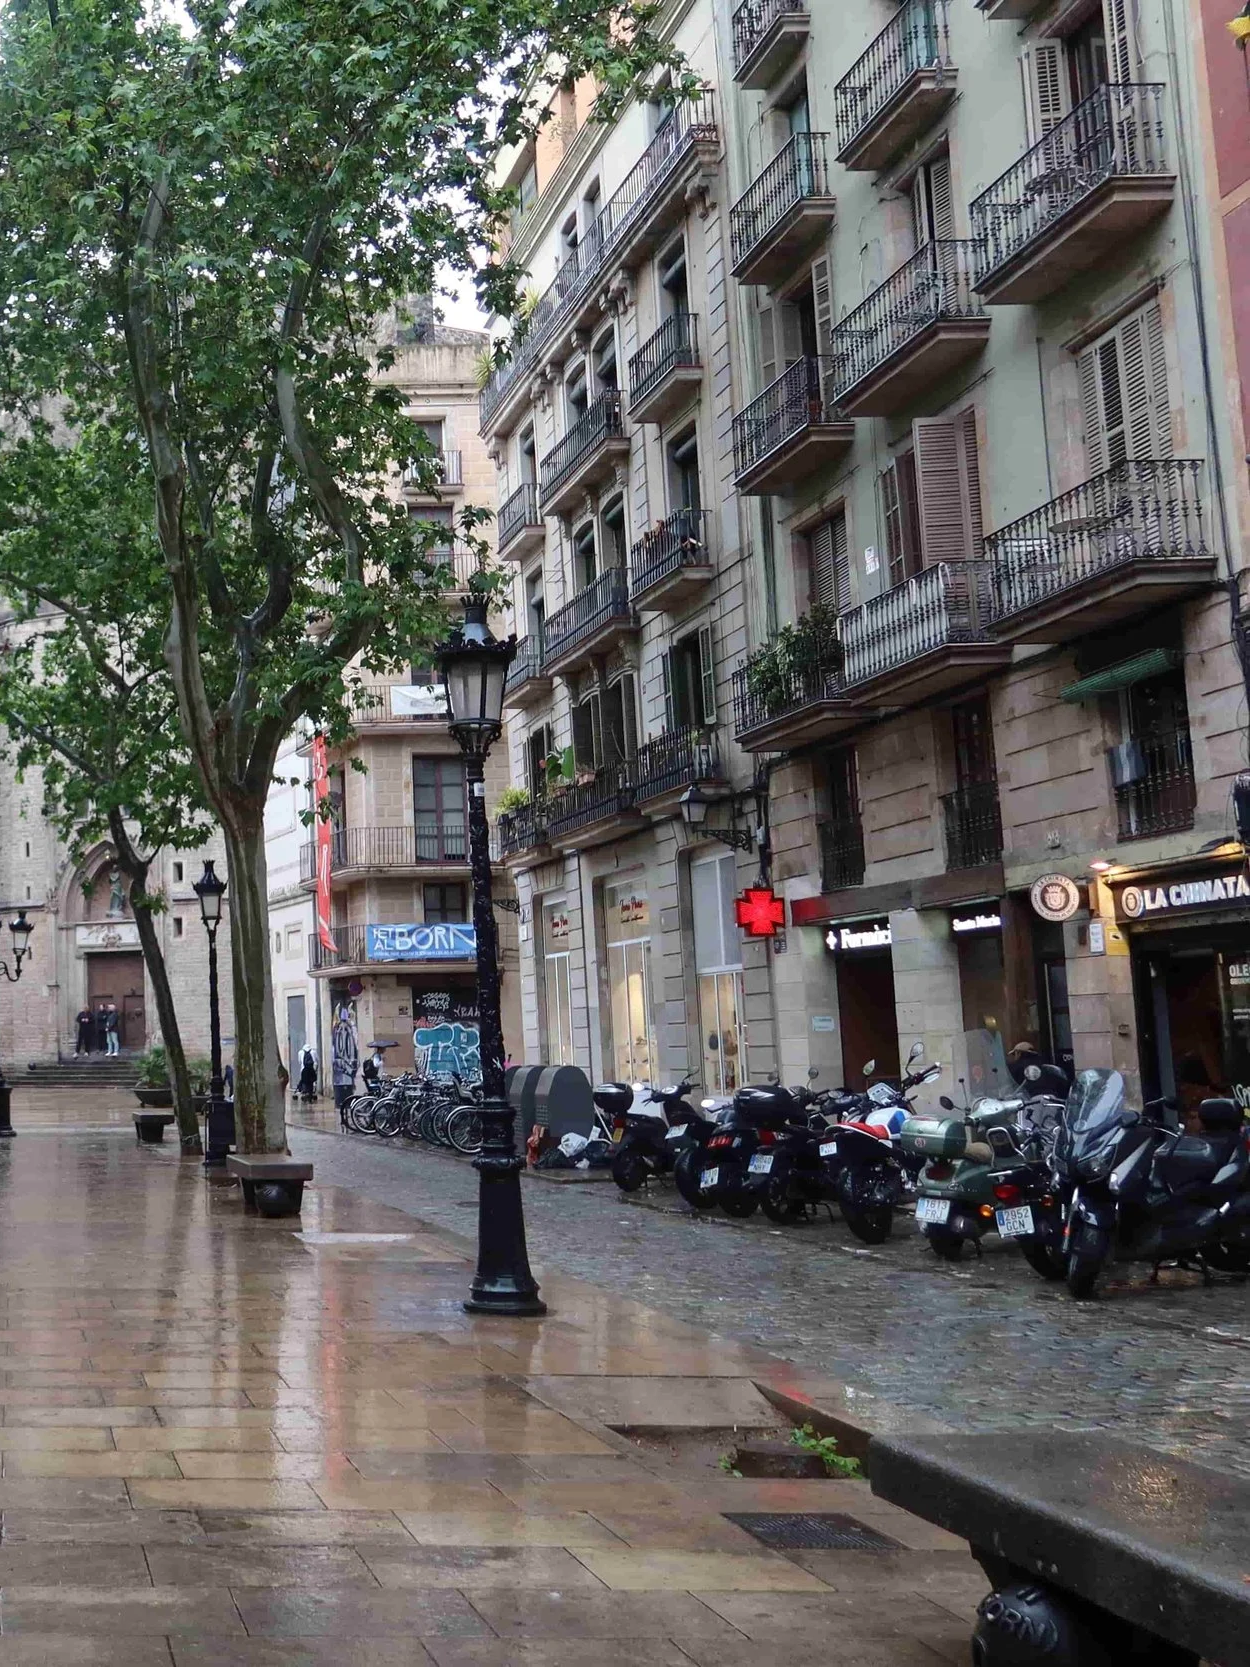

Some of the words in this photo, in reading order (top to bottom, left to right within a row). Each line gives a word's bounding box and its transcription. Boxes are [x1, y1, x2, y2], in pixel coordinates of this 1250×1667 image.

[1144, 888, 1168, 909] LA
[1169, 875, 1250, 906] CHINATA
[1229, 964, 1250, 978] OLE
[925, 1200, 948, 1210] 1613
[924, 1210, 944, 1218] FRJ
[1005, 1208, 1030, 1222] 2952
[1006, 1219, 1026, 1231] GCN
